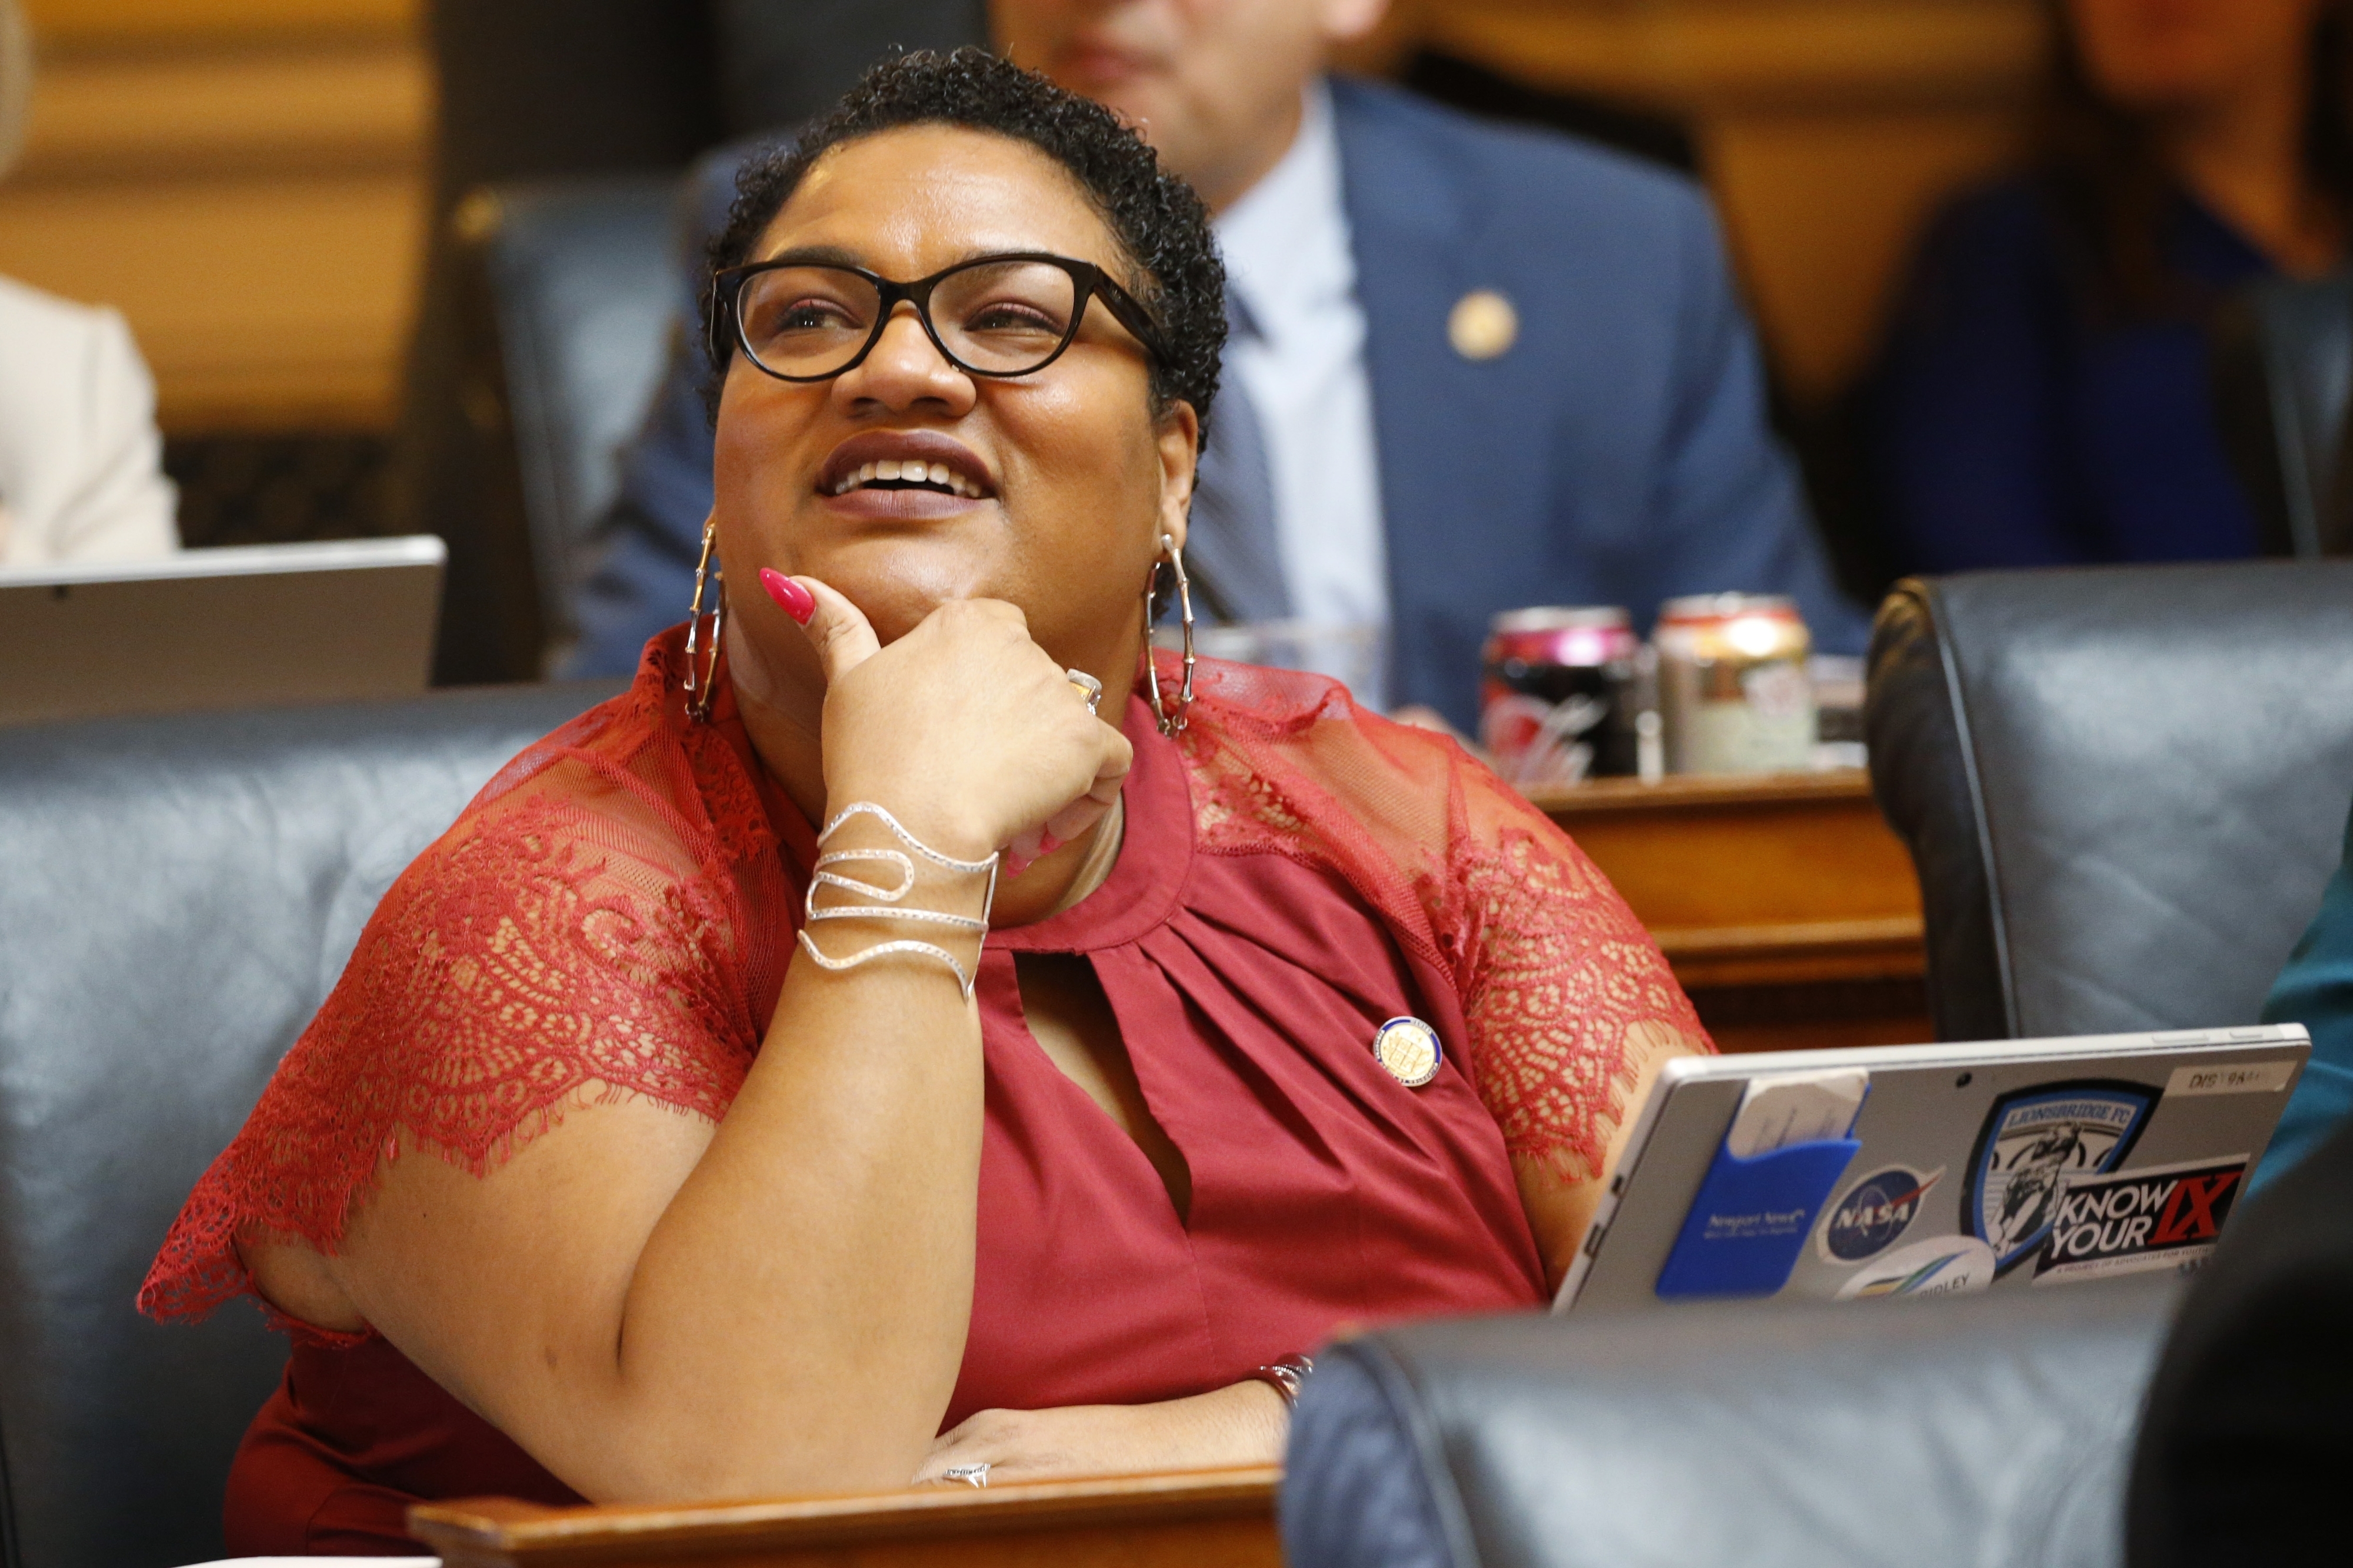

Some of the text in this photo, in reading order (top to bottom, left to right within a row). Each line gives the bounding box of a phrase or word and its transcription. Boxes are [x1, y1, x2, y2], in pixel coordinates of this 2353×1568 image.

[2111, 1107, 2130, 1124] FC
[1835, 1202, 1910, 1229] NASA
[2054, 1179, 2179, 1227] KNOW
[2148, 1170, 2245, 1245] IX
[2051, 1215, 2152, 1259] YOUR
